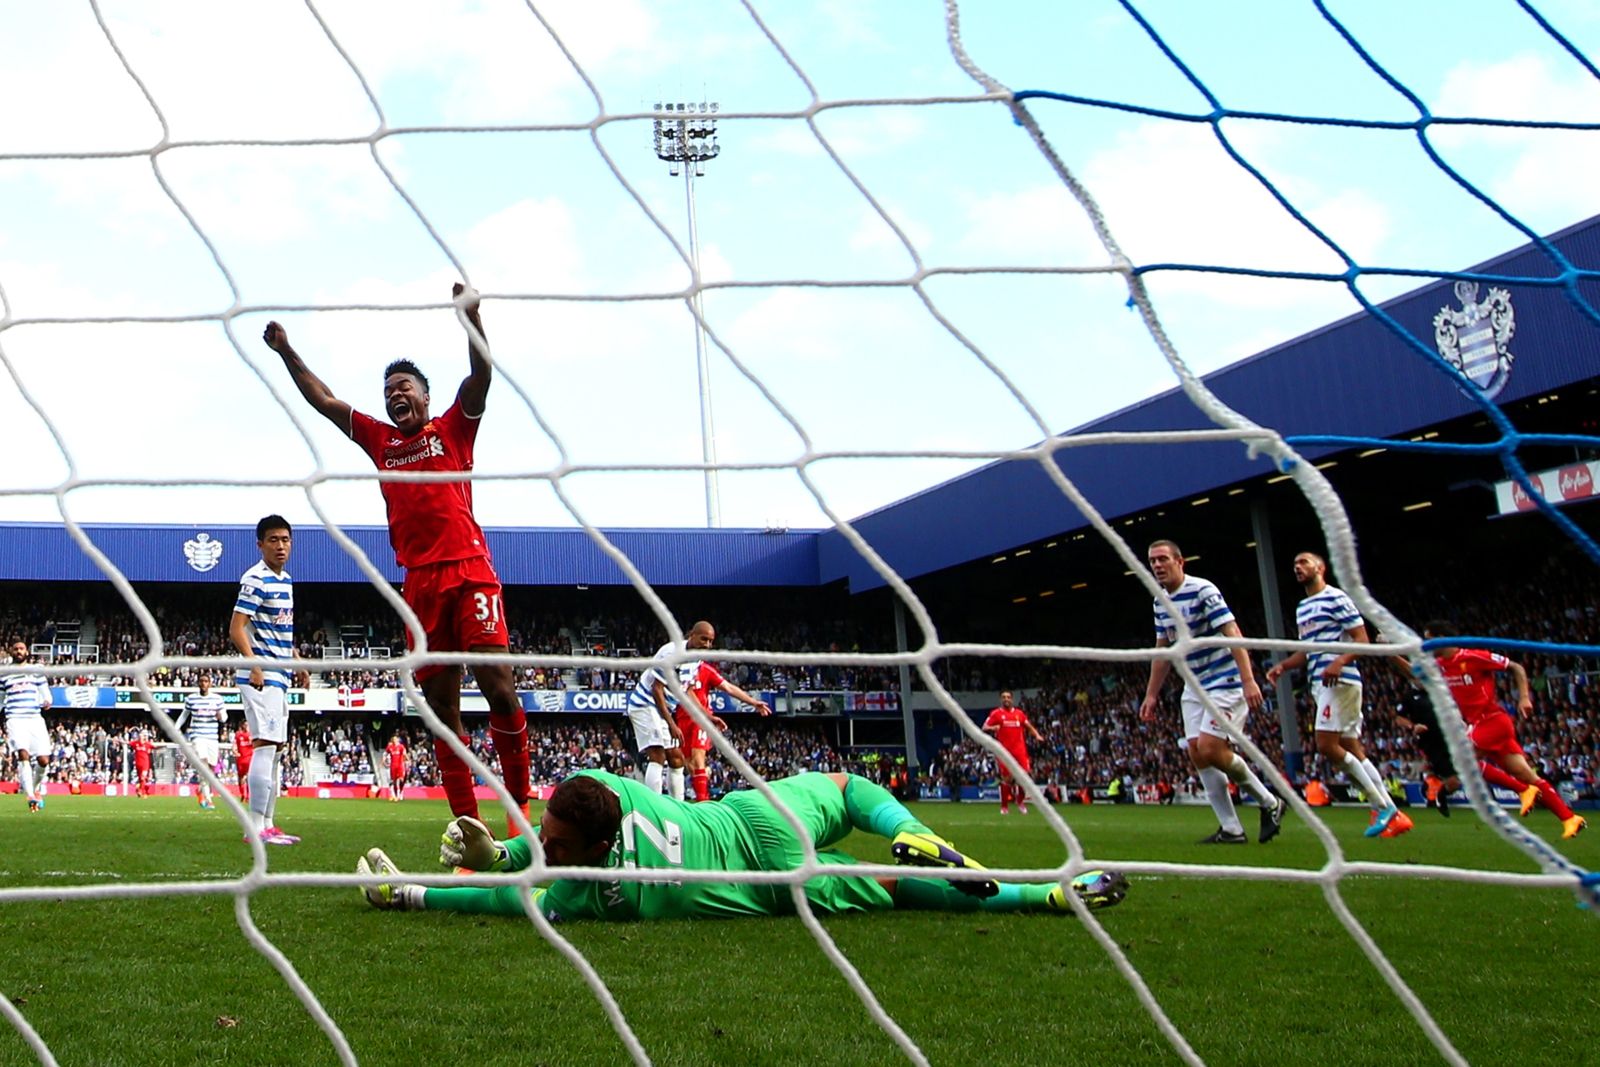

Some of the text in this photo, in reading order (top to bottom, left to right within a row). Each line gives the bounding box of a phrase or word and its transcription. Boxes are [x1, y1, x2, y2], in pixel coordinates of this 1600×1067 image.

[385, 436, 428, 457] Standard
[385, 447, 431, 469] Chartered
[473, 592, 499, 623] 31
[573, 692, 627, 710] COME
[1322, 704, 1331, 720] 4
